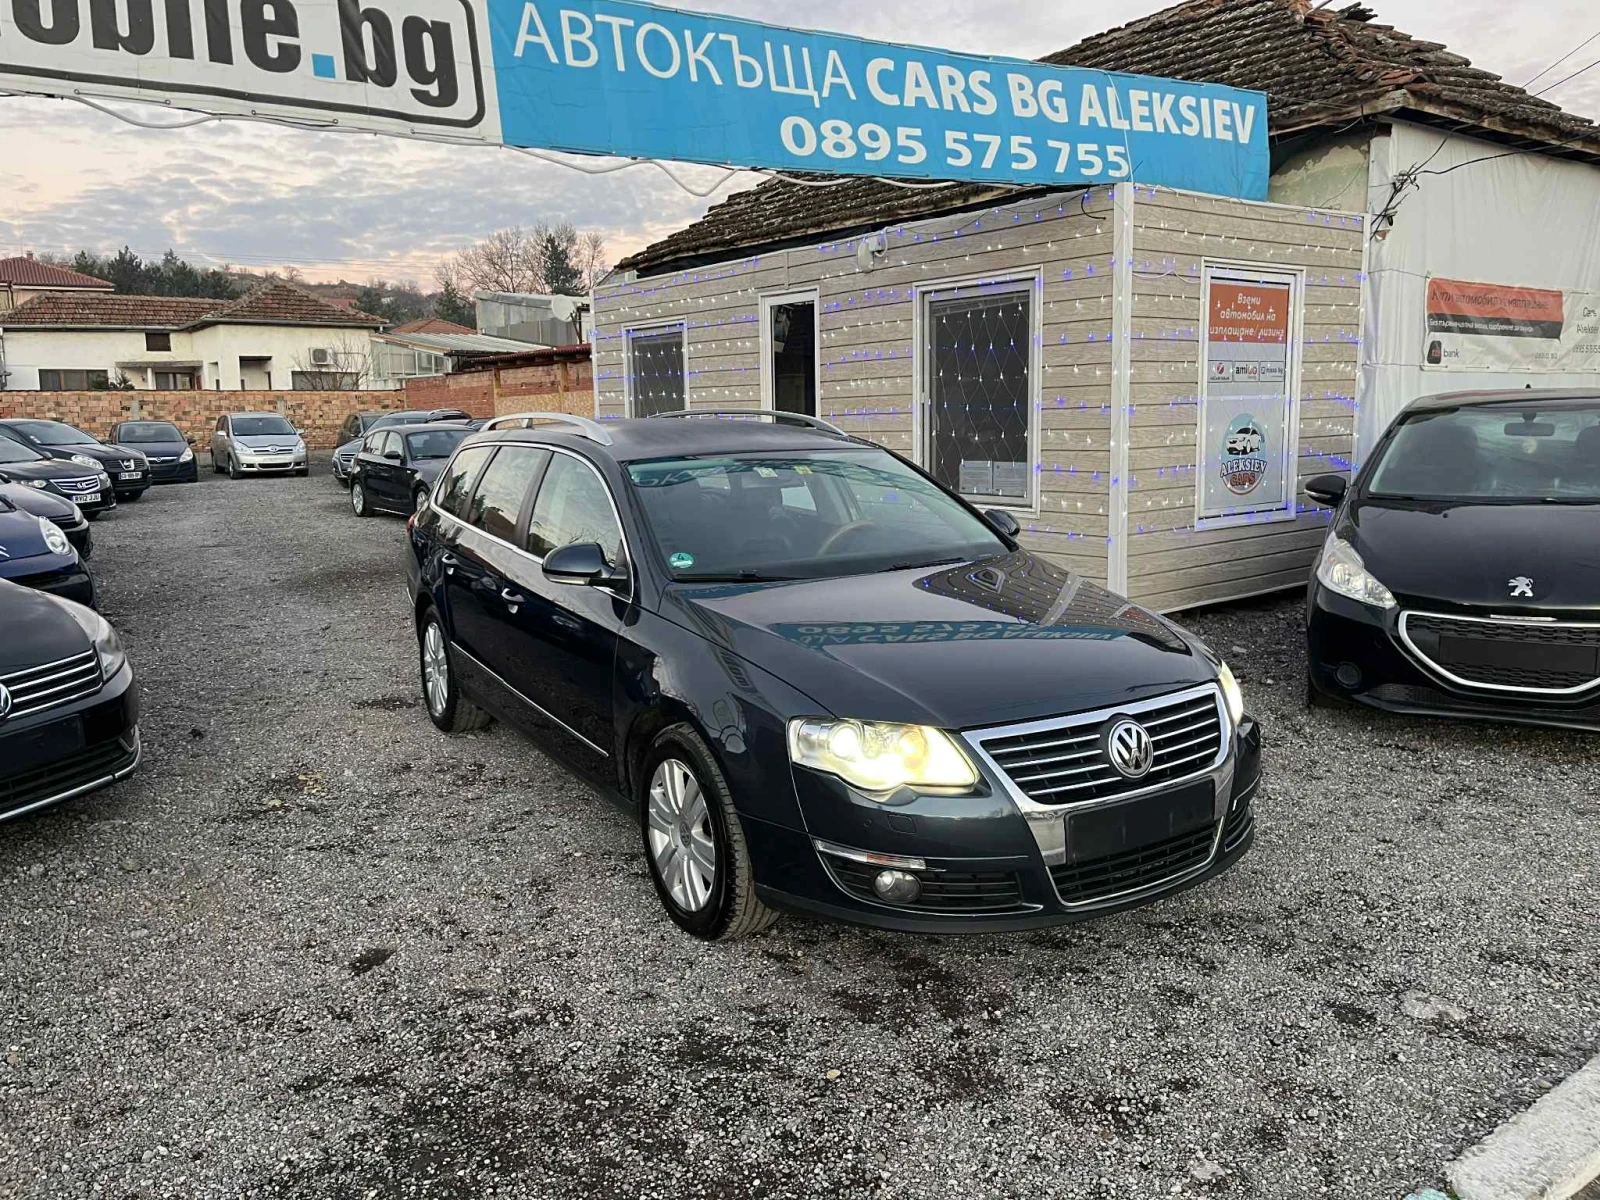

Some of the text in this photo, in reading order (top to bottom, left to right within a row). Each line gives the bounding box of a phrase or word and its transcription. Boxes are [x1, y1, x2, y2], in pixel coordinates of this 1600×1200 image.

[0, 0, 458, 107] obile.bg
[514, 2, 1254, 144] АВТОКЪЩА CARS BG ALEKSIEV
[780, 116, 1129, 177] 0895 575 755
[1220, 308, 1265, 321] автомобил
[1220, 458, 1268, 478] ALEKSIEV
